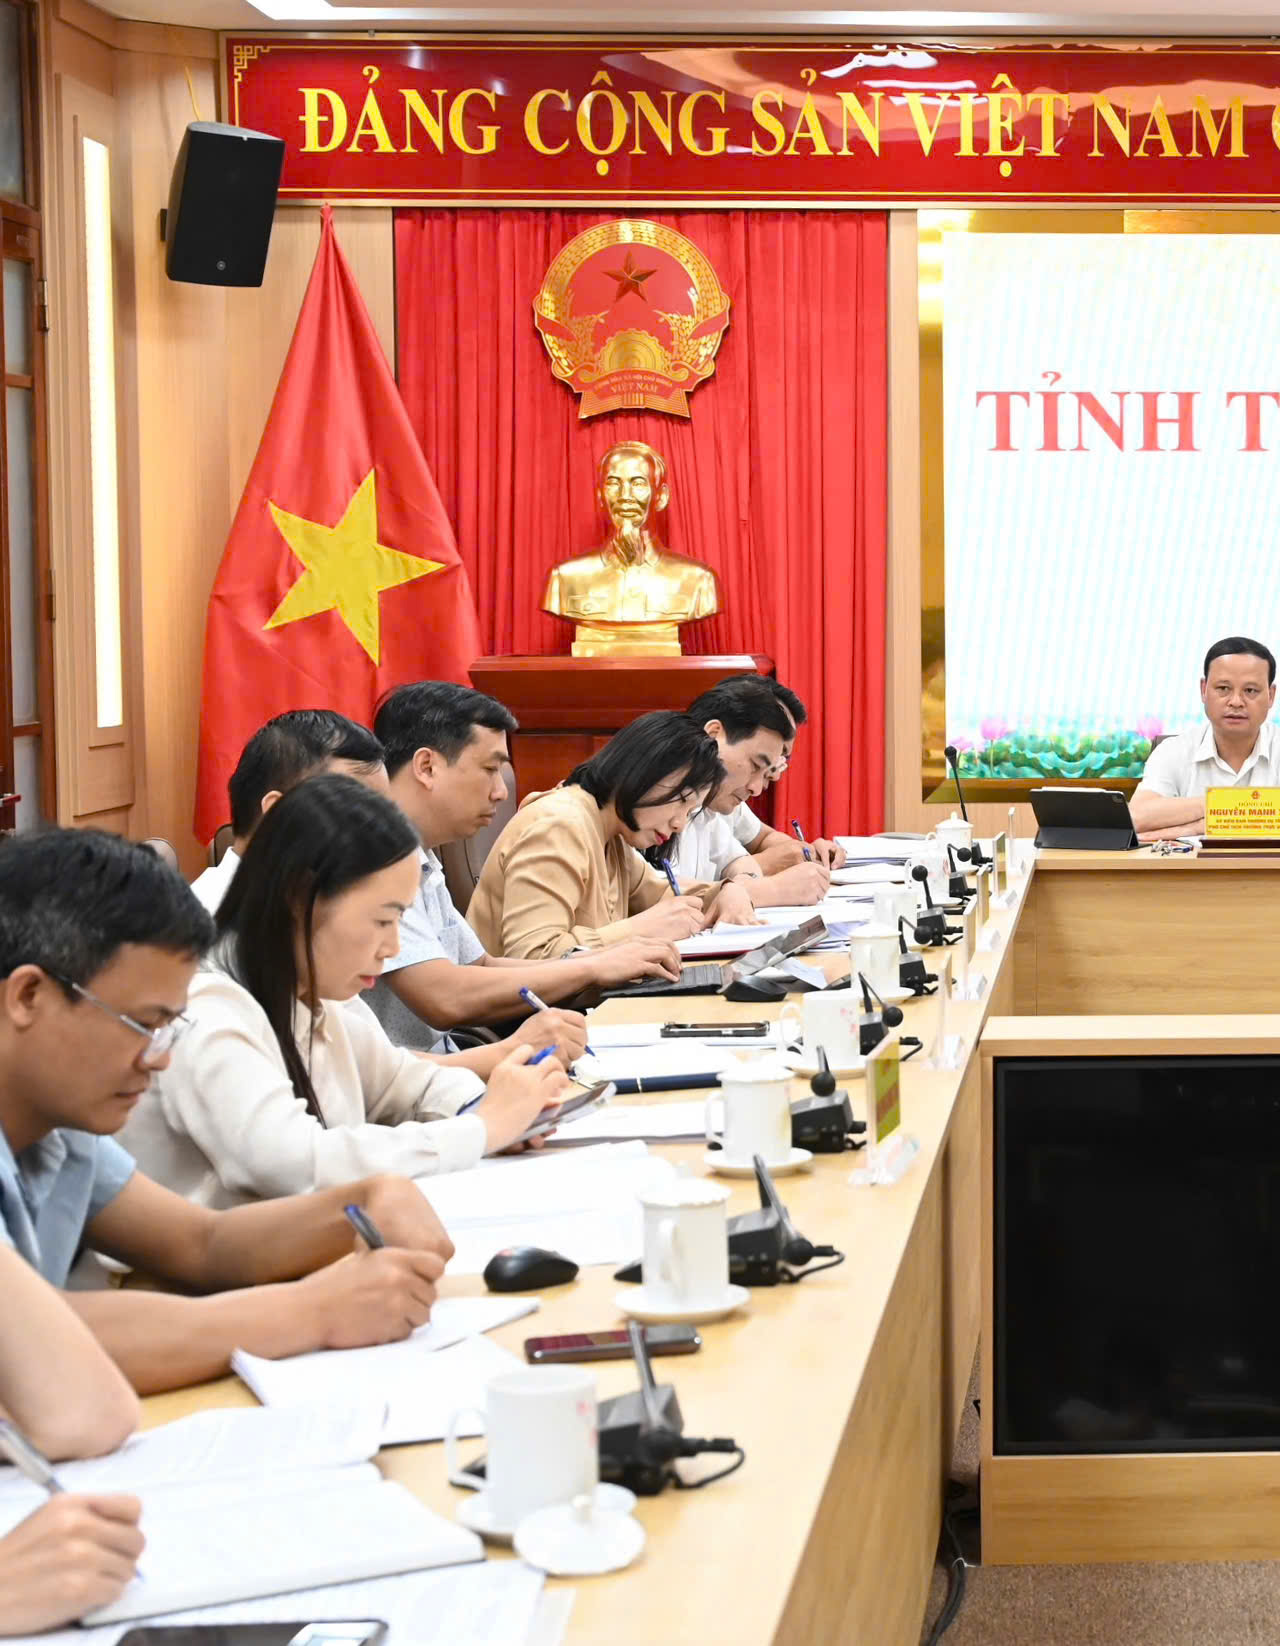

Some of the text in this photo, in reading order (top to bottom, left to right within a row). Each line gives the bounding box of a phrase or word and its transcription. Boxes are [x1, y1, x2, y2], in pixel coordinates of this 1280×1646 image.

[299, 66, 500, 155] ĐẢNG
[524, 71, 729, 176] CỘNG
[751, 68, 881, 157] SẢN
[903, 73, 1071, 176] VIỆT
[1087, 92, 1250, 158] NAM
[976, 371, 1201, 452] TỈNH
